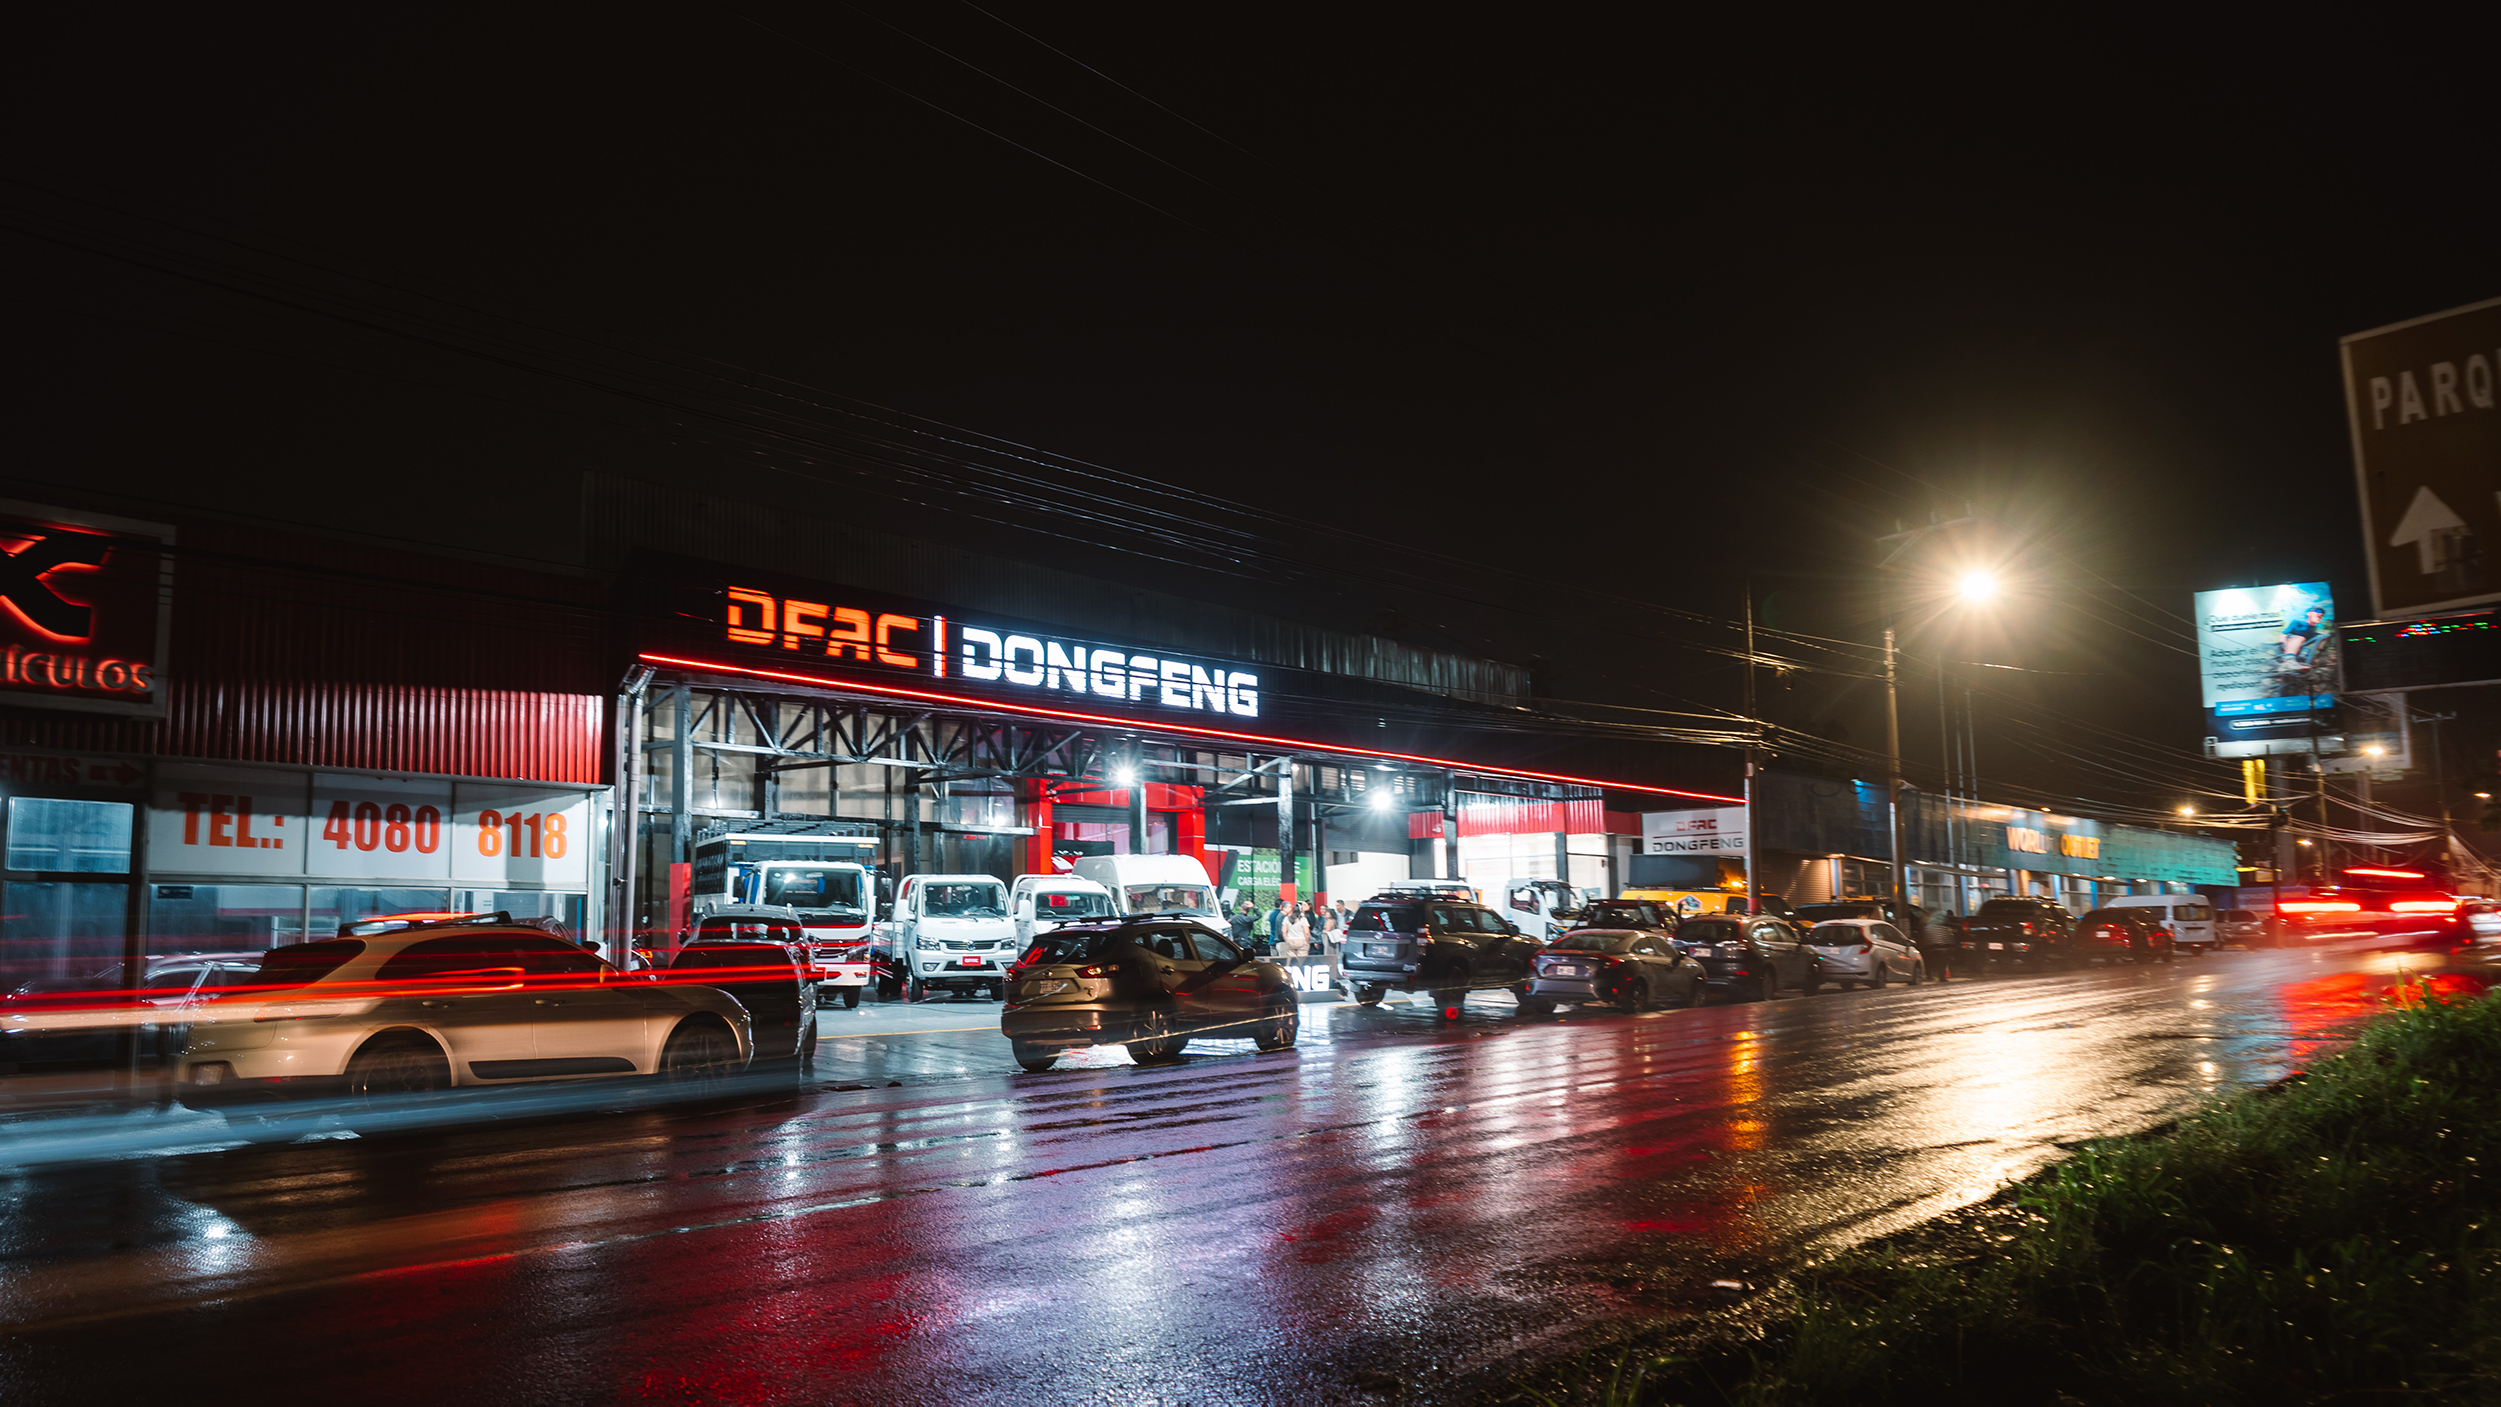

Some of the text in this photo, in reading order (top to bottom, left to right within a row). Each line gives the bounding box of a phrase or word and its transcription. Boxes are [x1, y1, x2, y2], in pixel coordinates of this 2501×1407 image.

[2369, 348, 2501, 430] PARQ
[0, 644, 155, 692] ÍCULOS
[727, 586, 1258, 717] DFAC DONGFENG
[178, 792, 567, 859] TEL.: 4080 8118
[1652, 837, 1744, 852] DONGFENG
[1675, 819, 1718, 831] DFAC
